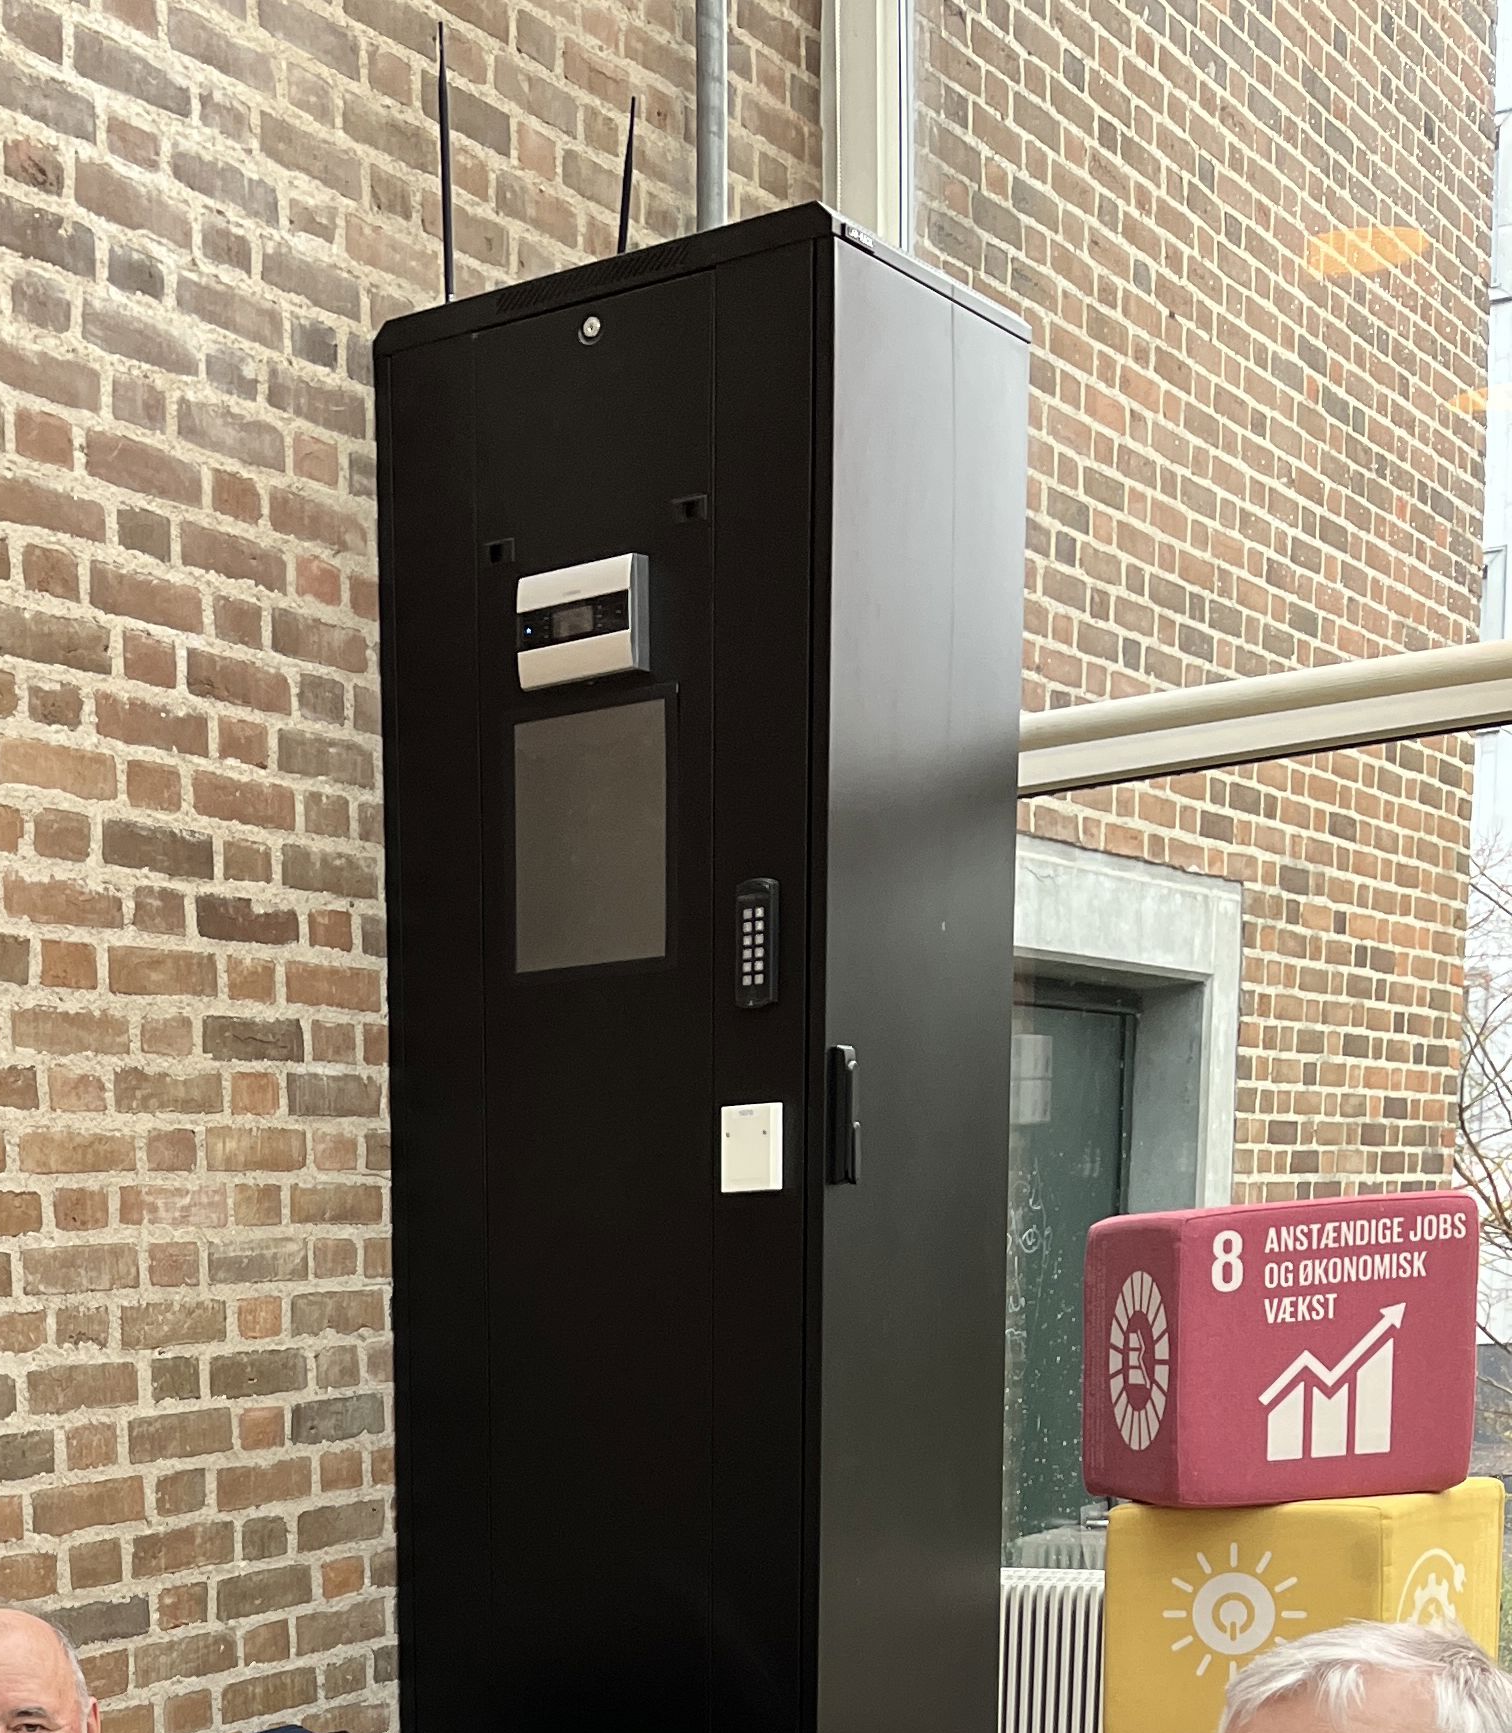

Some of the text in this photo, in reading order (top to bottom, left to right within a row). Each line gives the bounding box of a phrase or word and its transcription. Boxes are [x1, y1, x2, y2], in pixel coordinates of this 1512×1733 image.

[1264, 1212, 1467, 1254] ANSTÆNDIGE JOBS
[1211, 1229, 1244, 1293] 8
[1264, 1251, 1428, 1289] OG ØKONOMISK
[1264, 1293, 1338, 1324] VÆKST
